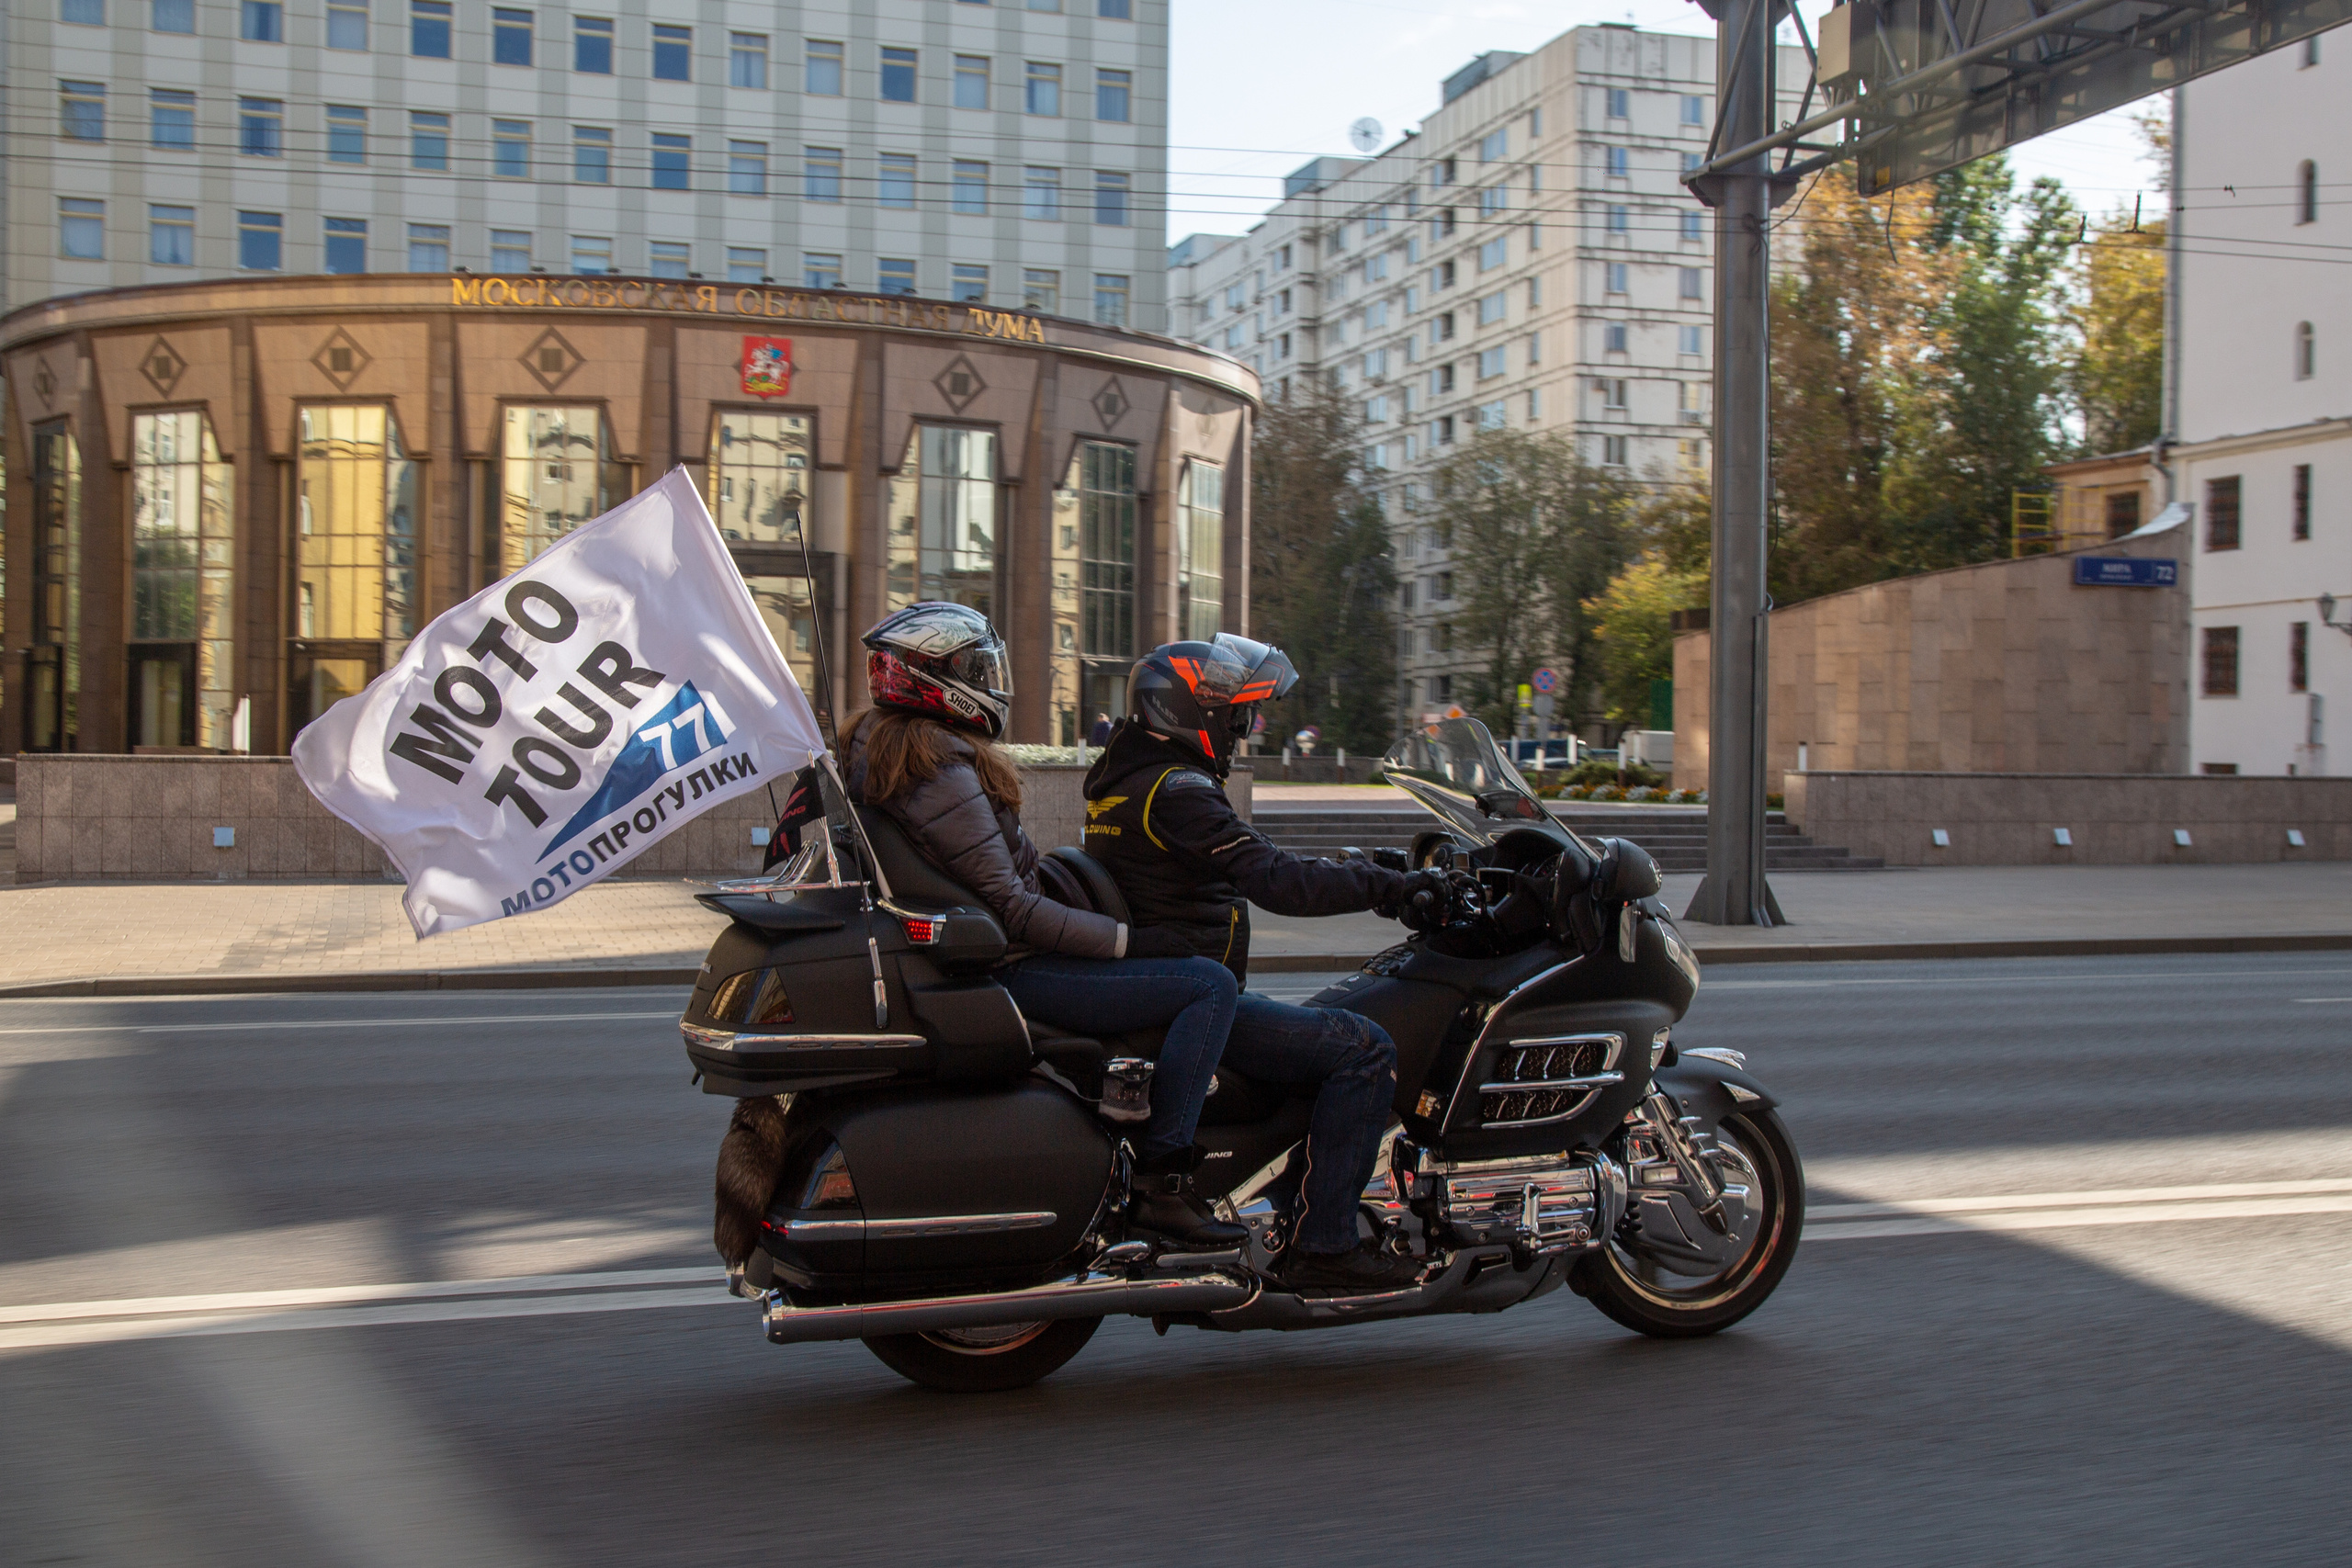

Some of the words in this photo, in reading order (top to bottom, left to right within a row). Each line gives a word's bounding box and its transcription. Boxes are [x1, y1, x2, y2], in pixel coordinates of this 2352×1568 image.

[451, 278, 718, 312] МОСКОВСКАЯ
[736, 288, 951, 332] ОБЛАСТНАЯ
[960, 307, 1046, 344] ДУМА
[2156, 565, 2175, 581] 72
[389, 580, 579, 785] MOTO
[947, 692, 976, 715] SHOEI
[484, 640, 666, 829] TOUR
[638, 701, 712, 771] 77
[501, 752, 758, 916] МОТОПРОГУЛКИ
